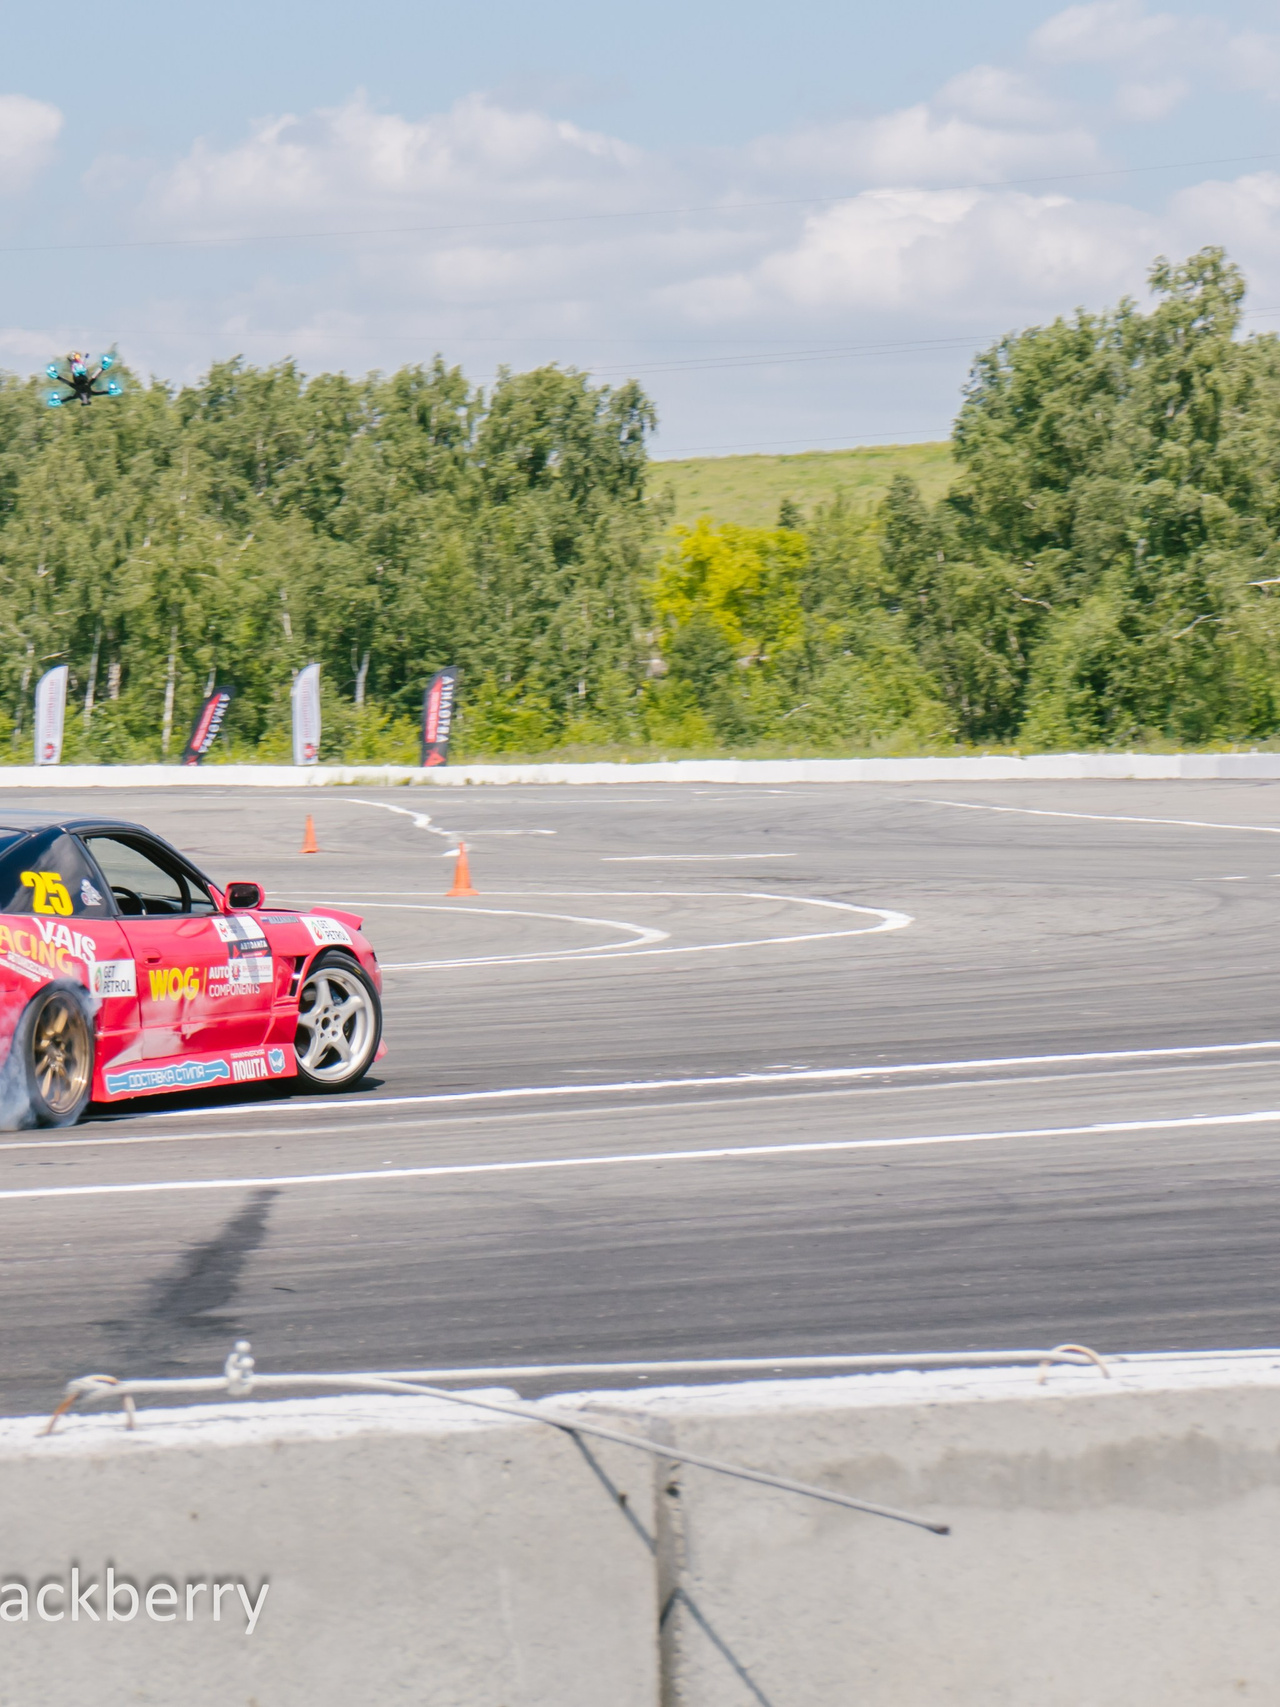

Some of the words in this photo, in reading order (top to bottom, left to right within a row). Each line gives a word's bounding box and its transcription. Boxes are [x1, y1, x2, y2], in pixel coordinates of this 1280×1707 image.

[20, 871, 73, 916] 25
[32, 917, 97, 964] VAIS
[103, 966, 116, 979] GET
[209, 966, 230, 979] AUTO
[103, 979, 131, 993] PETROL
[149, 967, 200, 1001] WOG
[209, 983, 260, 997] COMPONENTS
[128, 1069, 176, 1088] ДОСТАВКА
[176, 1066, 205, 1082] СТИЛЯ
[232, 1058, 268, 1081] ПОШТА
